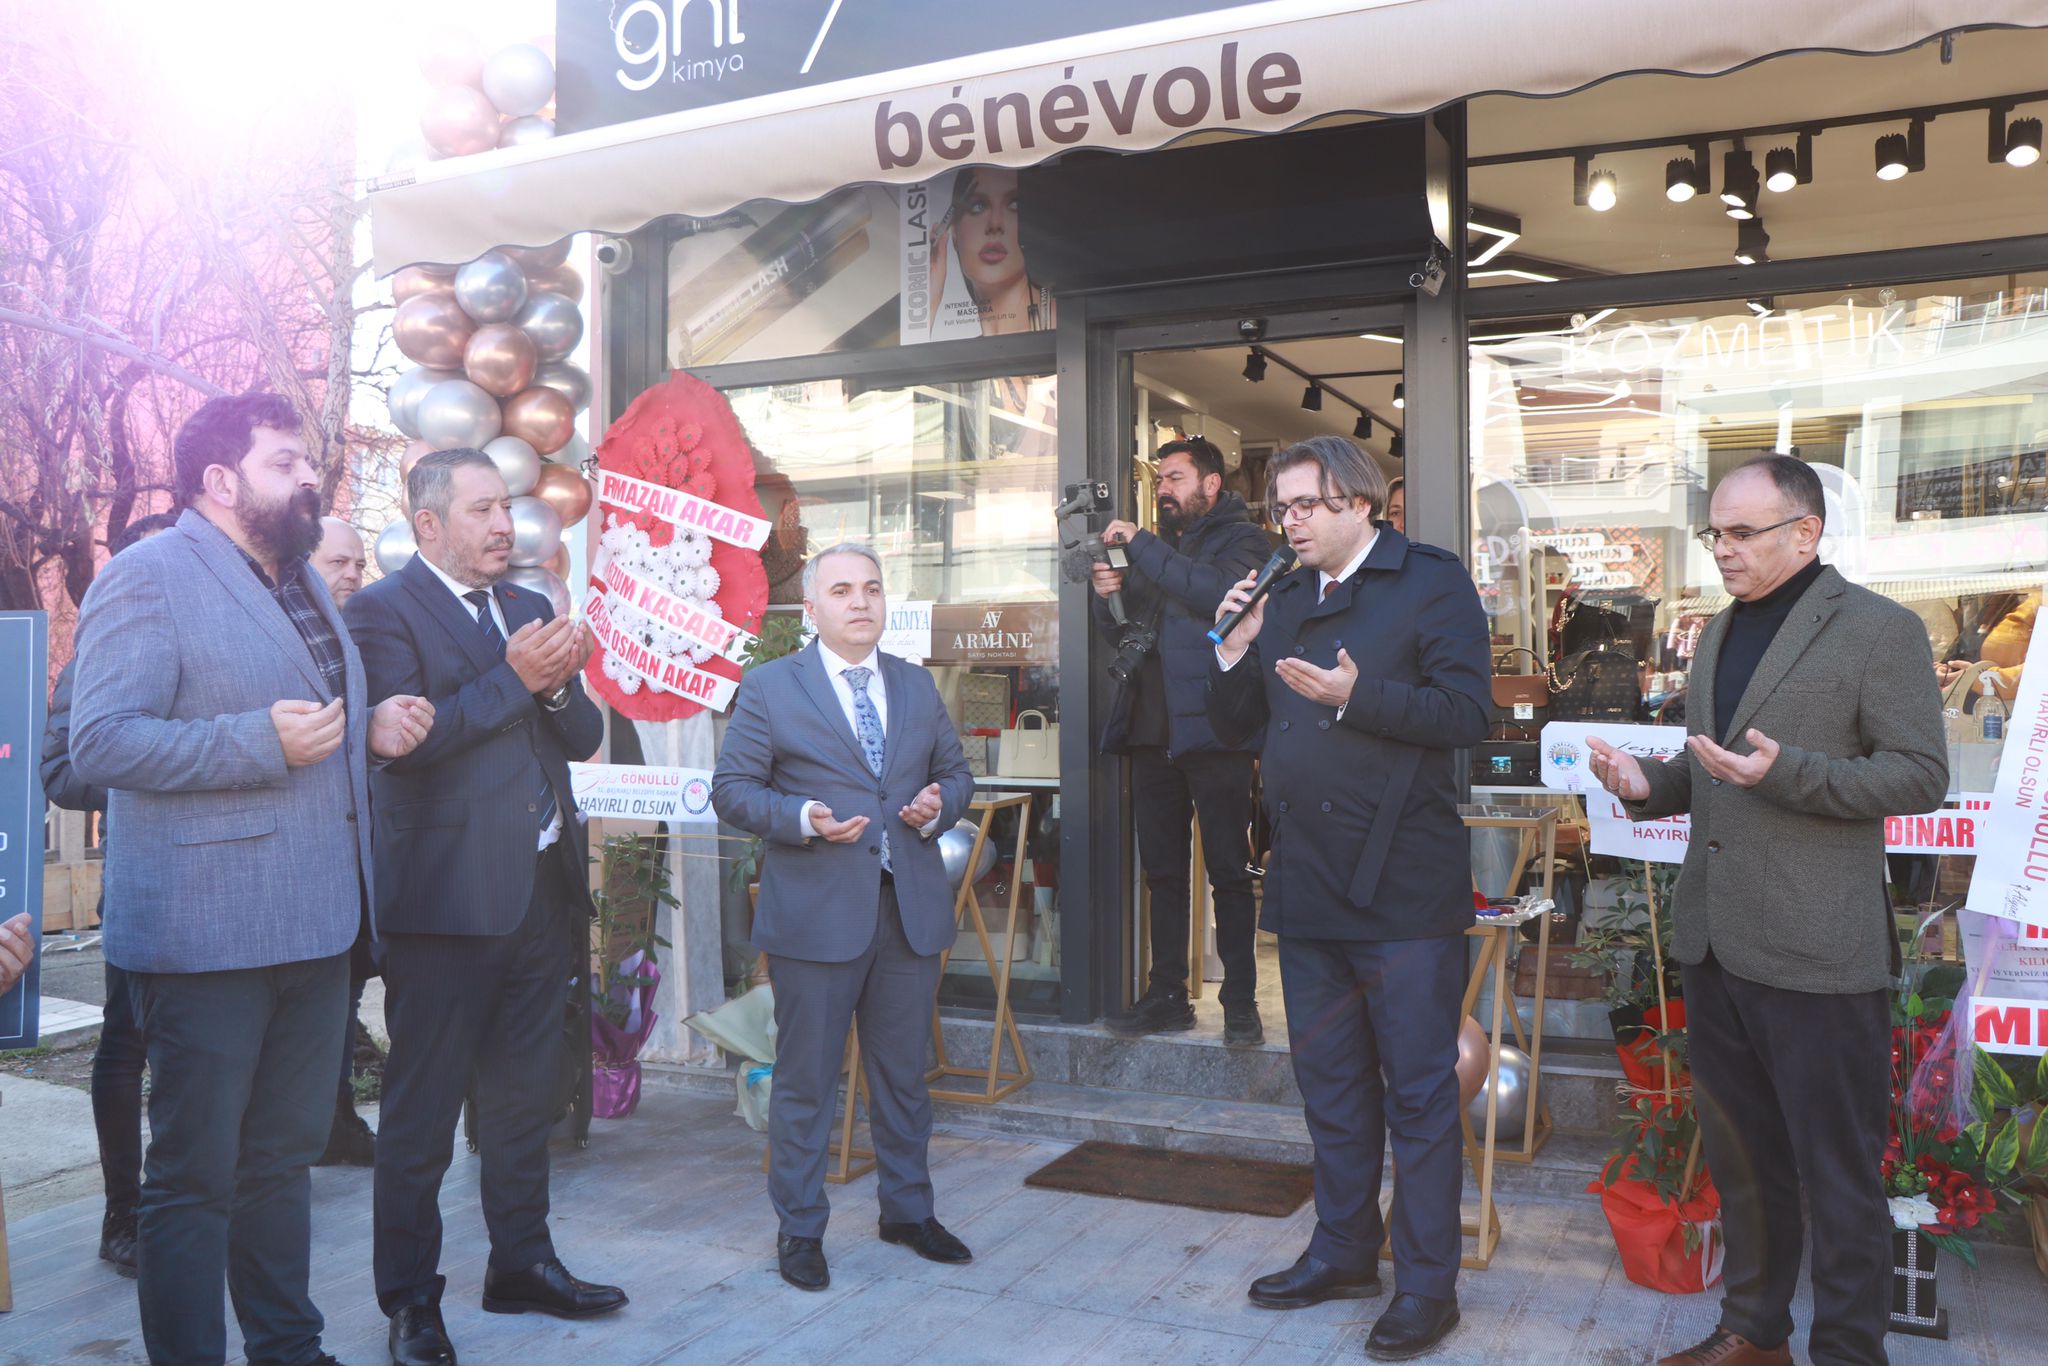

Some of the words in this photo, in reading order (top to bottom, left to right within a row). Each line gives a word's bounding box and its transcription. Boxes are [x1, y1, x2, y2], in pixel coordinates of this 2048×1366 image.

[672, 54, 744, 83] kimya
[875, 41, 1303, 170] bénévole
[944, 300, 971, 310] INTENSE
[957, 305, 993, 317] MASCARA
[1567, 297, 1906, 374] KOZMETİK
[678, 498, 755, 543] AKAR
[890, 605, 930, 632] KİMYA
[611, 630, 661, 679] OSMAN
[662, 659, 718, 701] AKAR
[620, 771, 680, 786] GÖNÜLLÜ
[2015, 755, 2042, 809] OLSUN
[579, 797, 629, 813] HAYIRLI
[632, 799, 677, 815] OLSUN
[1974, 1003, 2048, 1048] M
